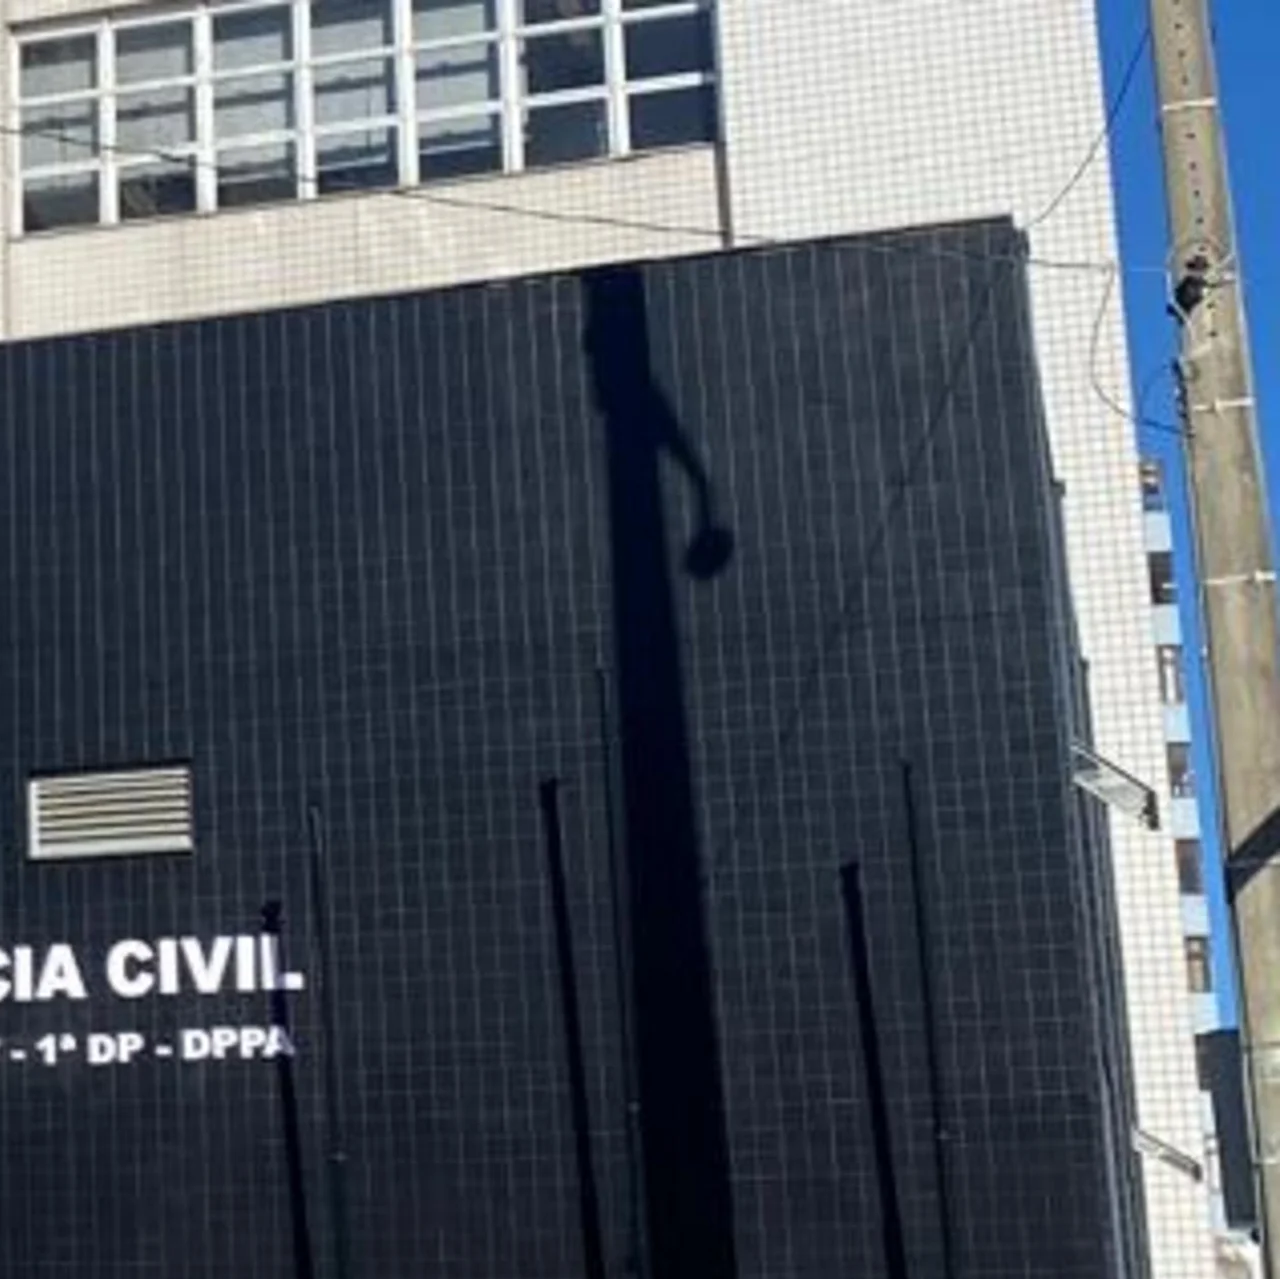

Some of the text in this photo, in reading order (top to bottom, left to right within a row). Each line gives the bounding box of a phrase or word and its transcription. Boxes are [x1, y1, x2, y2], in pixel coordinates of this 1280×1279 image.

[107, 934, 304, 997] CIVIL
[87, 1031, 146, 1065] DP
[181, 1025, 295, 1061] DPPA
